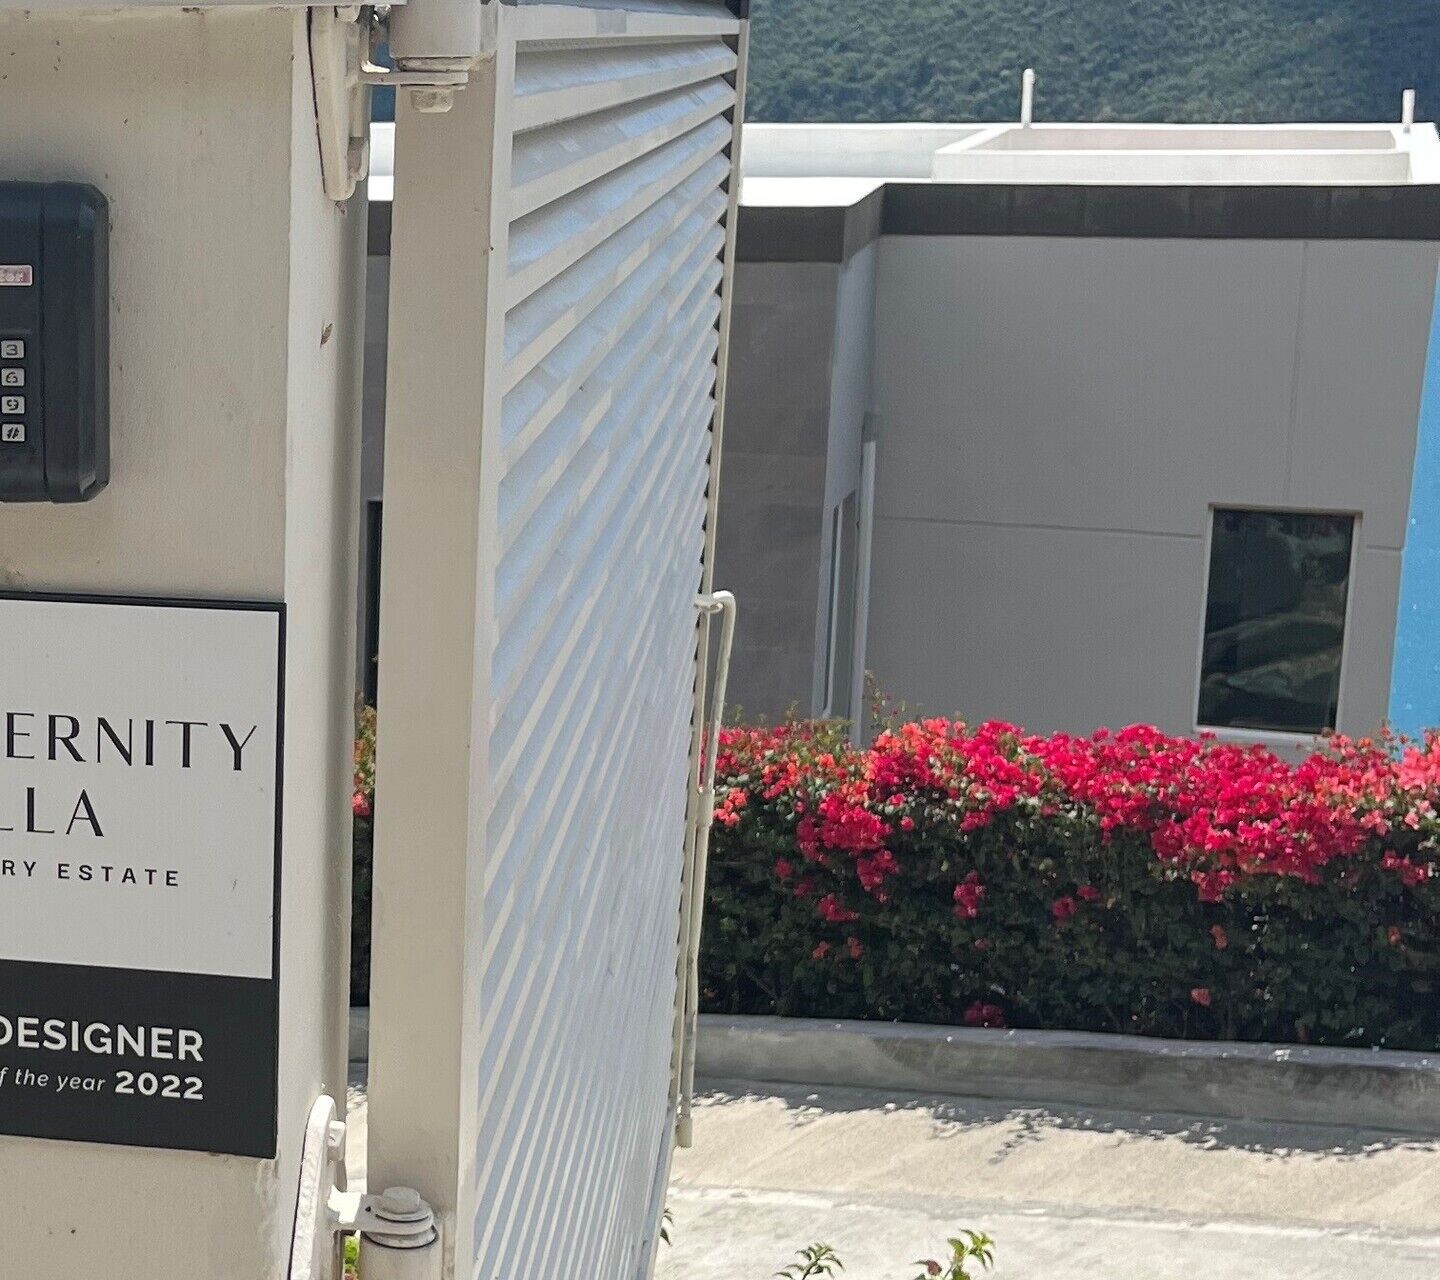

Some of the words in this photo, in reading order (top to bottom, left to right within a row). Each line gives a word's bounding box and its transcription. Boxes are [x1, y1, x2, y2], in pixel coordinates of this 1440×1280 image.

[6, 344, 19, 356] 3
[5, 371, 19, 384] 6
[6, 399, 20, 411] 9
[58, 864, 178, 886] ESTATE
[16, 1069, 48, 1086] the
[56, 1076, 105, 1092] year
[116, 1071, 203, 1099] 2022
